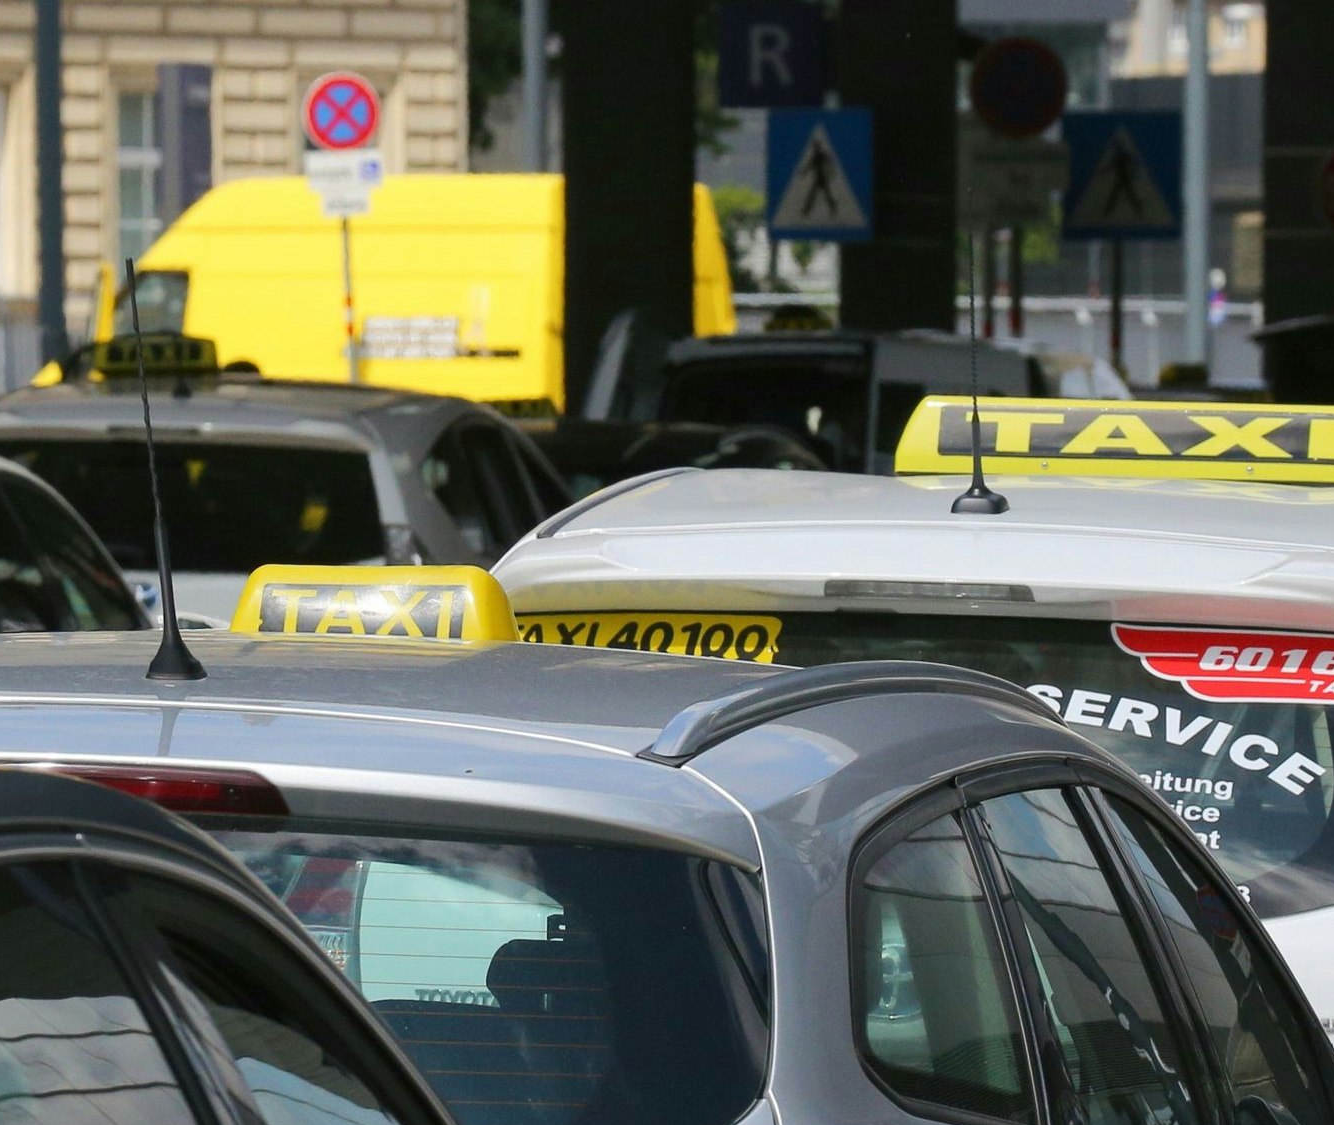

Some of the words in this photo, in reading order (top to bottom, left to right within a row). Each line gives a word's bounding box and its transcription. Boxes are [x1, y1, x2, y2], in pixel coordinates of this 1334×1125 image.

[749, 24, 793, 86] R
[271, 589, 455, 640] TAXI
[519, 622, 599, 647] AXI
[1024, 683, 1327, 796] SERVICE
[1168, 800, 1221, 823] ice
